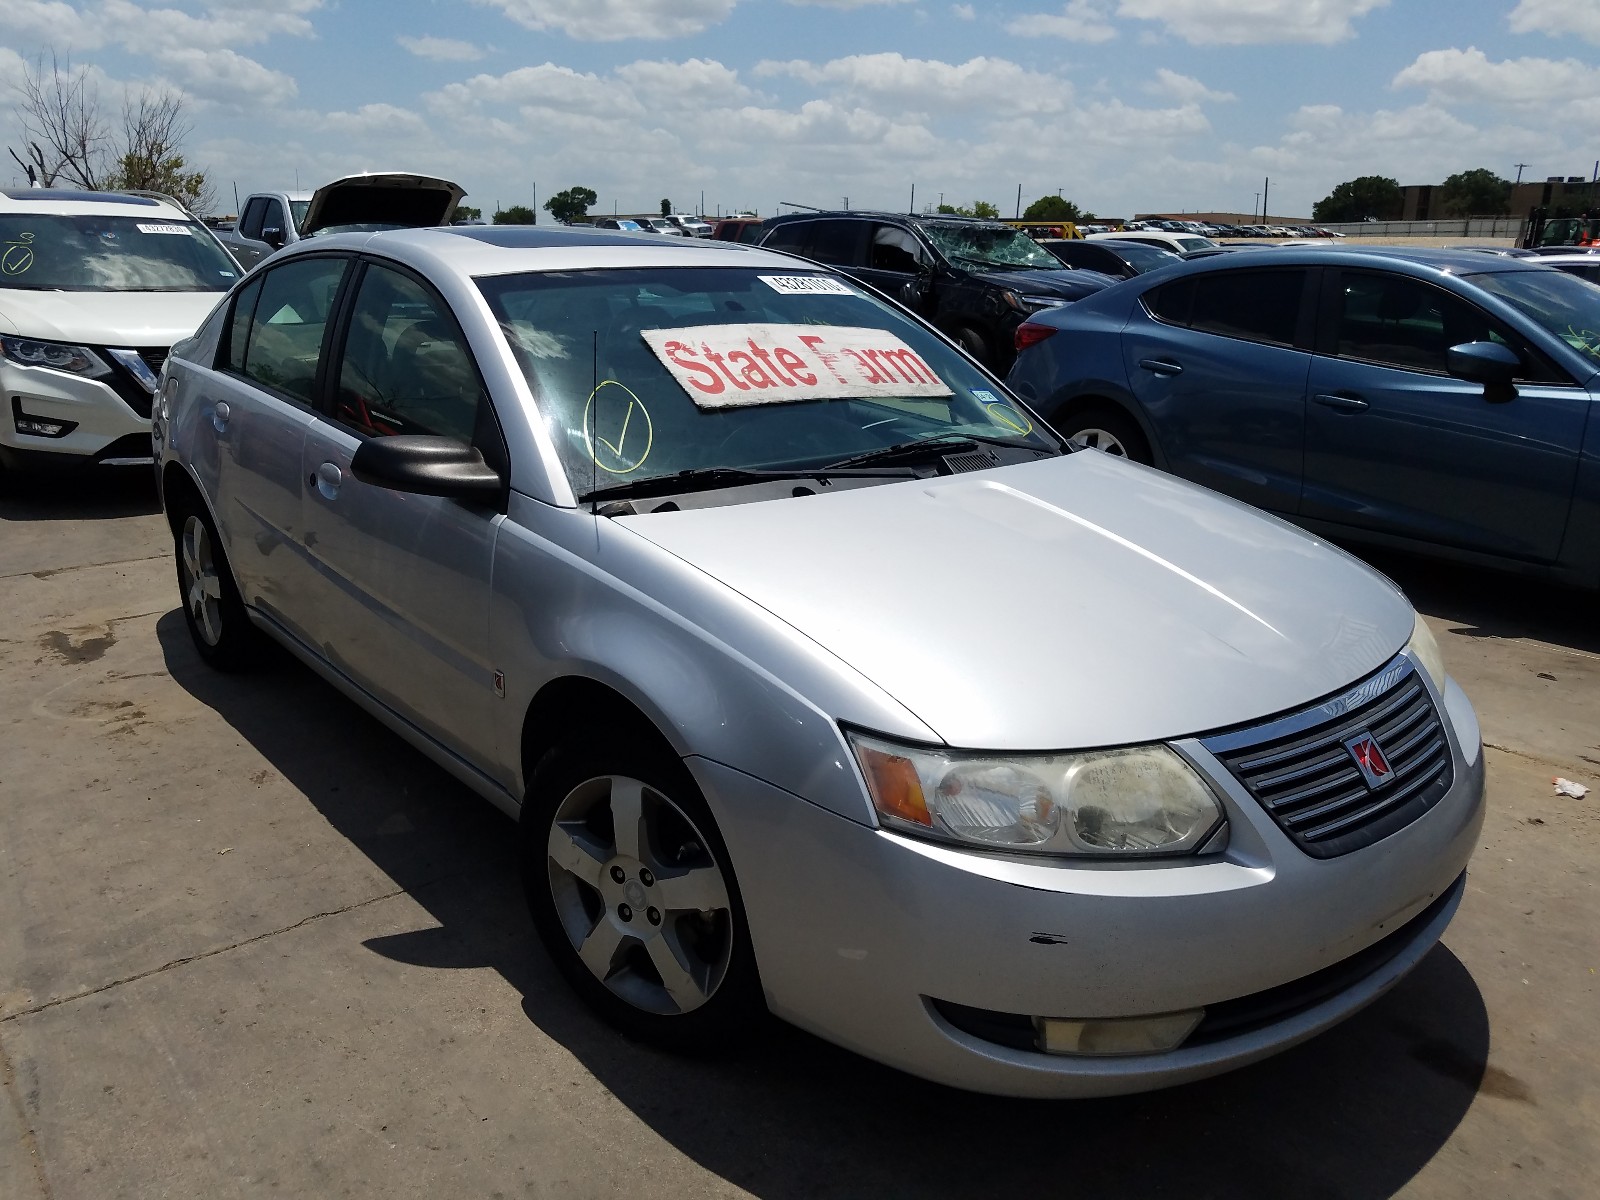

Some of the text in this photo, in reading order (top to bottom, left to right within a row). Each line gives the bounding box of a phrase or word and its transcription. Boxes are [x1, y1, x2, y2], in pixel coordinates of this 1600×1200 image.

[772, 277, 841, 291] 43281010
[664, 335, 941, 394] State Farm
